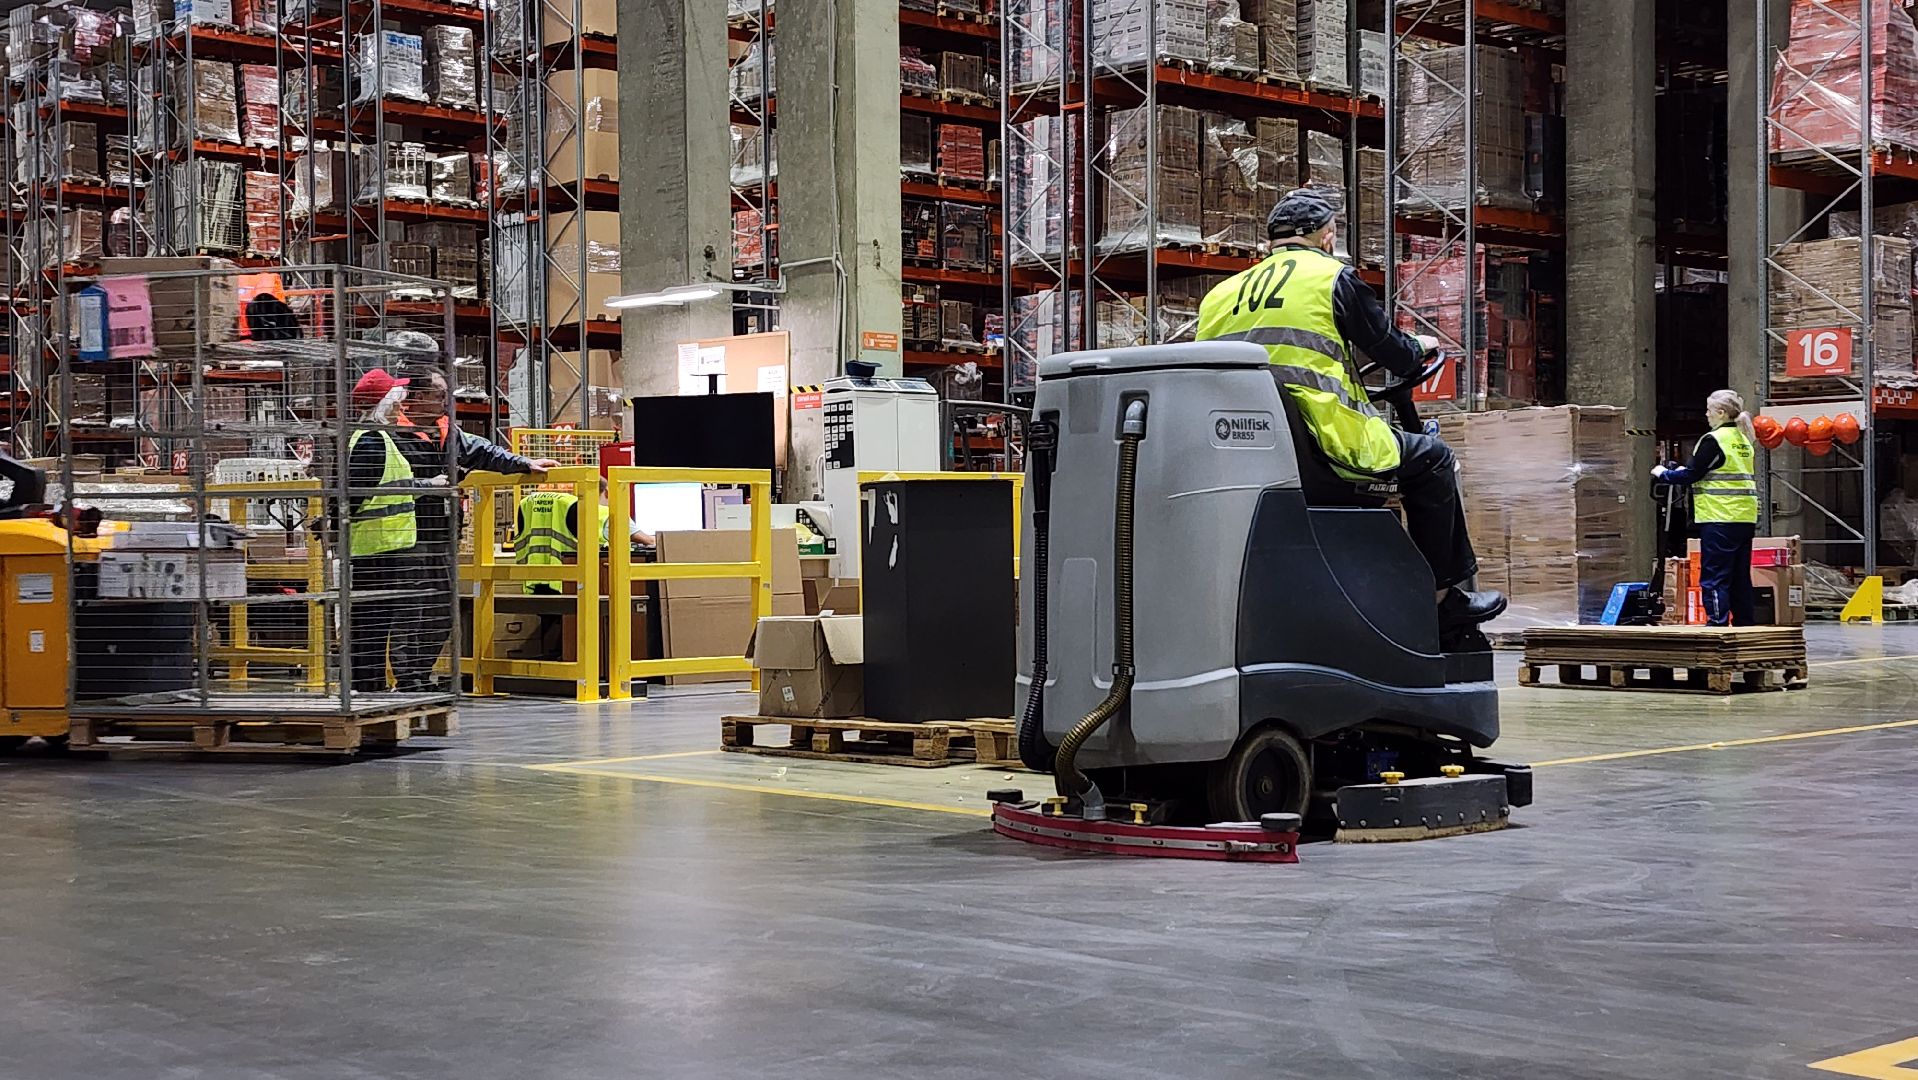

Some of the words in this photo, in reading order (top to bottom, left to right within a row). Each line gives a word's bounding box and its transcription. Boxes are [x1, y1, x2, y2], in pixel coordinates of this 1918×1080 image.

[1232, 259, 1297, 316] 102
[1799, 332, 1838, 366] 16
[1231, 418, 1270, 431] Nilfisk
[174, 453, 187, 469] 26
